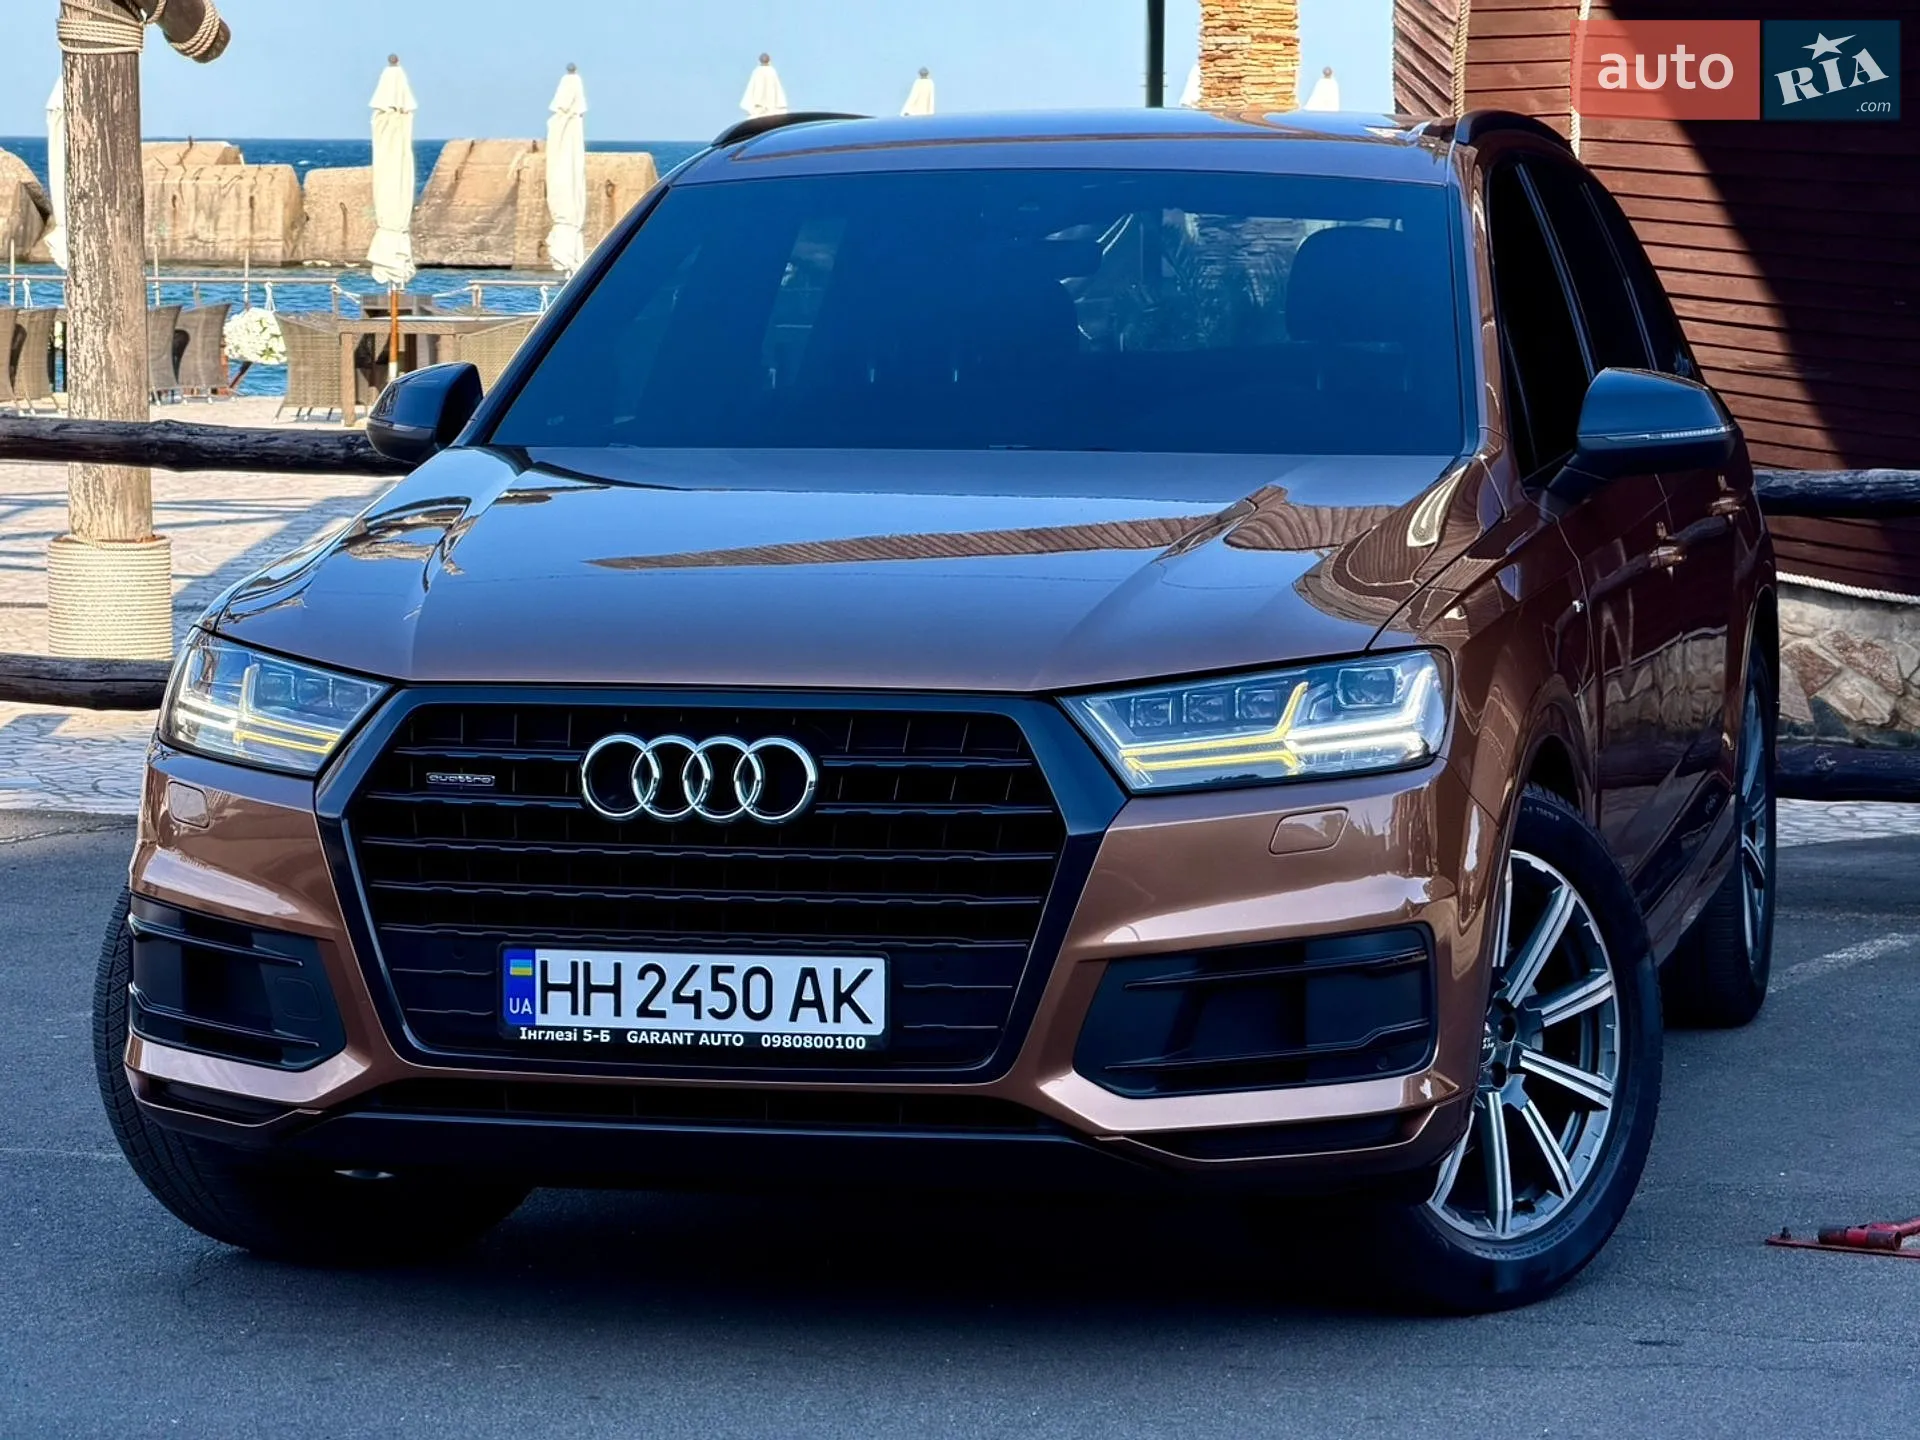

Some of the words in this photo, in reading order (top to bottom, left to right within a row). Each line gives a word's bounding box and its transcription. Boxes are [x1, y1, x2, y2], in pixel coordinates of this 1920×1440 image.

[428, 774, 492, 784] quattro
[540, 960, 622, 1018] HH
[636, 962, 774, 1022] 2450
[788, 967, 874, 1025] AK
[509, 997, 533, 1015] UA
[519, 1027, 578, 1042] Інглезі
[583, 1029, 611, 1043] 5-Б
[626, 1030, 695, 1046] GARANT
[698, 1033, 744, 1047] AUTO
[761, 1034, 866, 1049] 0980800100
